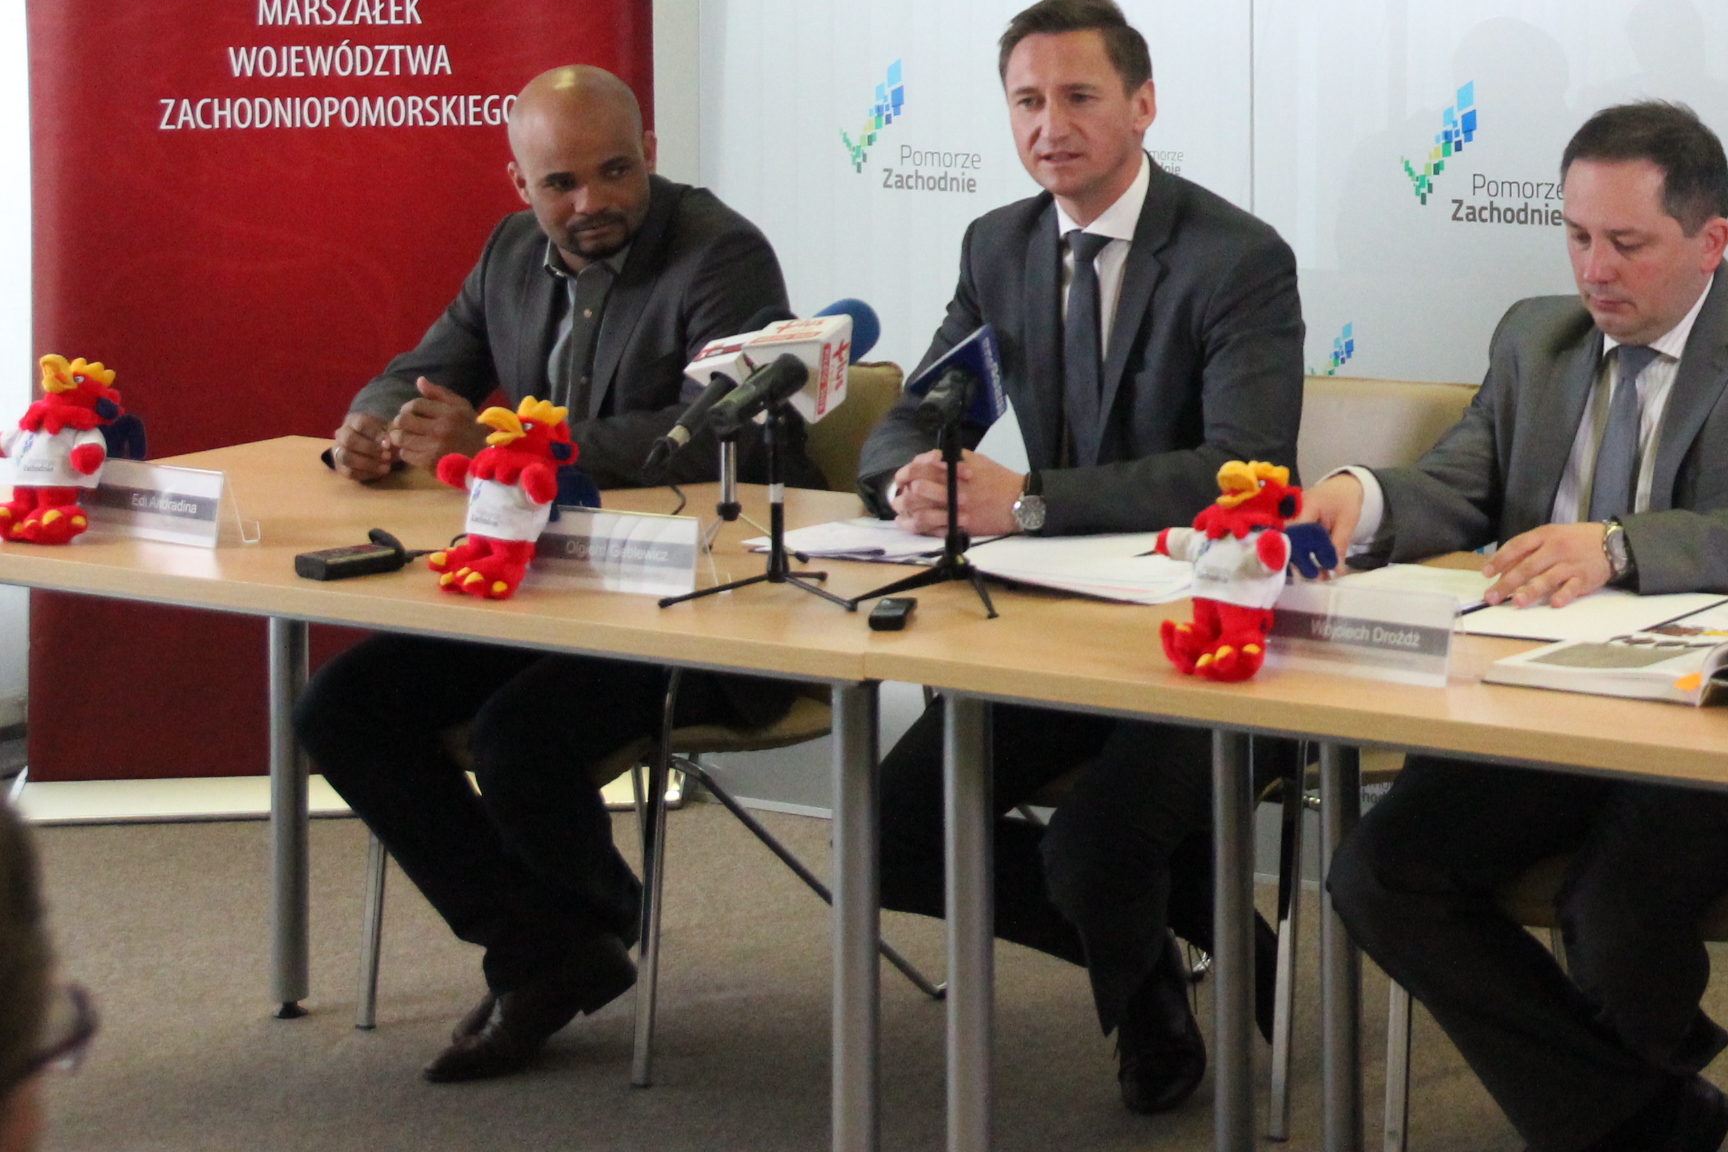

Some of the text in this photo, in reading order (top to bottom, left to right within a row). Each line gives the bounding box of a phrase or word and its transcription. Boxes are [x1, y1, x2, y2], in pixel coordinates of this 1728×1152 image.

[229, 40, 452, 77] WOJEWÓDZTWA
[900, 144, 982, 170] Pomorze
[1149, 150, 1184, 162] morze
[882, 168, 977, 193] Zachodnie
[1472, 173, 1564, 200] Pomorze
[1451, 198, 1563, 226] Zachodnie
[149, 496, 197, 514] Andradina
